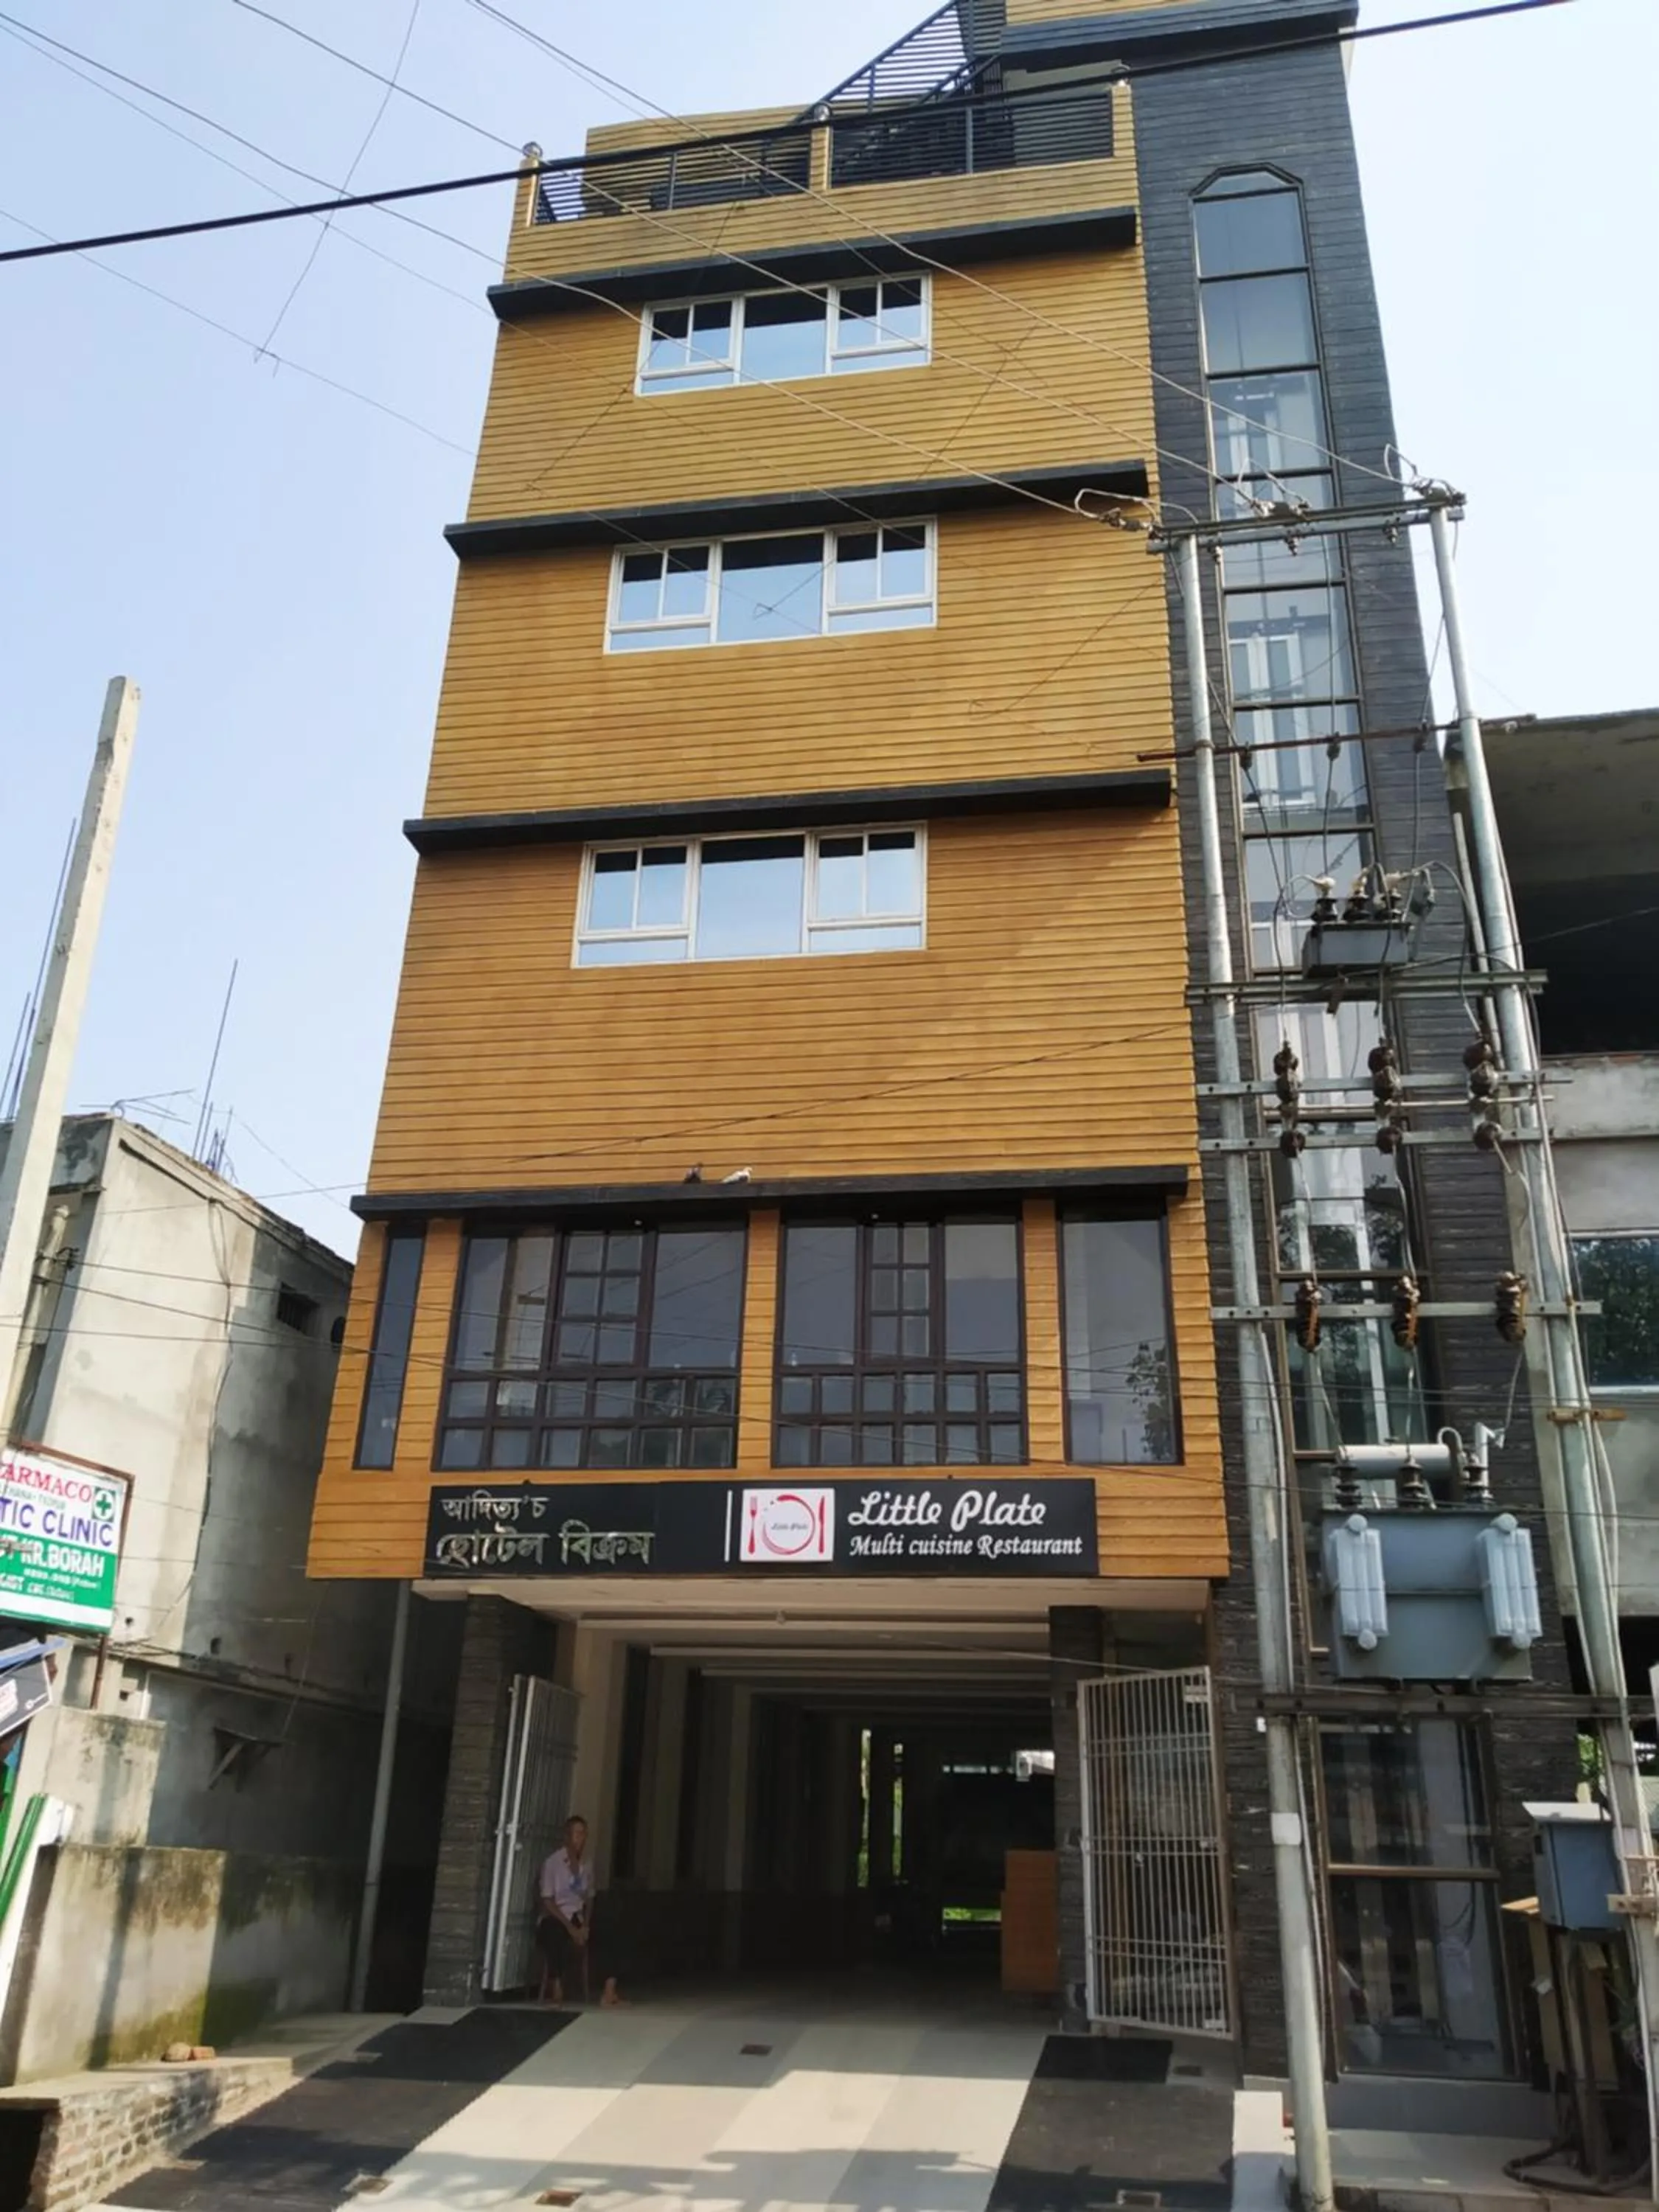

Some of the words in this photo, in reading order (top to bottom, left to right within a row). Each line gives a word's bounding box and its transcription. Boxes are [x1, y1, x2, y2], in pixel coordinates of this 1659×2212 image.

[0, 1462, 92, 1503] ARMACO
[43, 1509, 113, 1547] CLINIC
[848, 1489, 942, 1526] Little
[950, 1490, 1046, 1531] Plate
[849, 1532, 903, 1557] Multi
[908, 1535, 973, 1555] cuisine
[977, 1534, 1083, 1559] Restaurant
